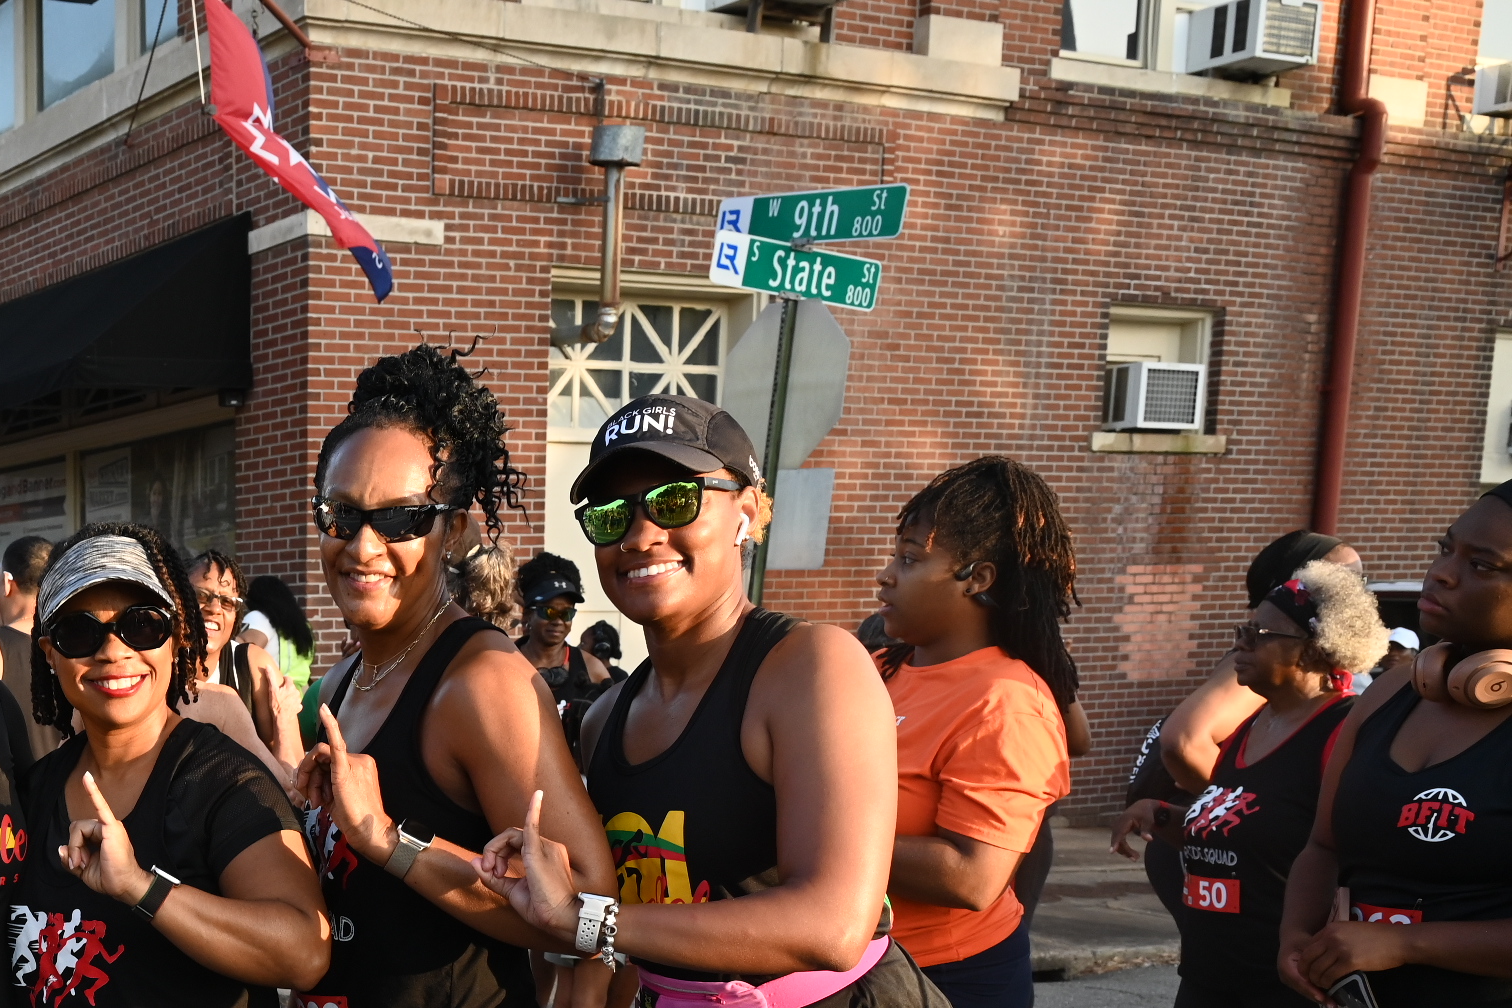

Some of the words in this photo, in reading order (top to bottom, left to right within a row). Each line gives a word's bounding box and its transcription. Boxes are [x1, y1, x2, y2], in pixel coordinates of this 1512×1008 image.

[768, 198, 781, 217] W
[792, 195, 839, 238] 9th
[871, 189, 888, 210] St
[852, 215, 882, 236] 800
[751, 241, 761, 261] S
[768, 250, 836, 297] State
[861, 264, 876, 284] St
[845, 284, 870, 307] 800
[642, 406, 676, 416] GIRLS
[605, 413, 675, 447] RUN!
[1203, 848, 1238, 866] SQUAD
[1199, 881, 1227, 909] 50
